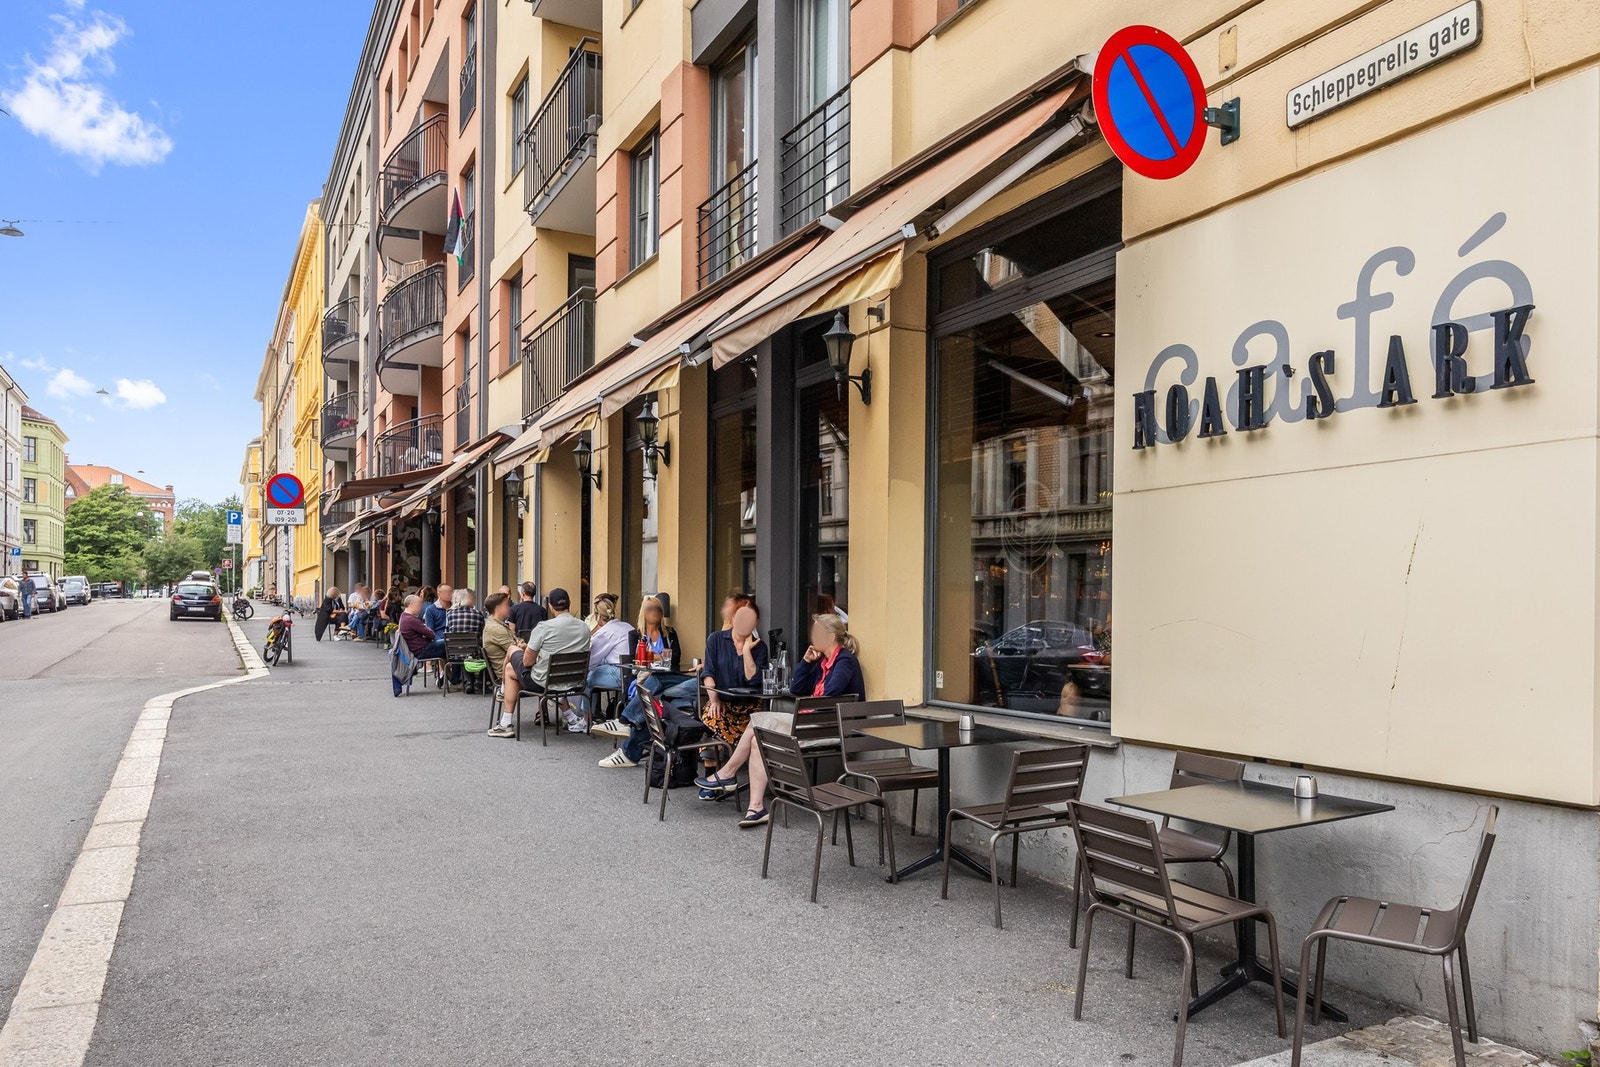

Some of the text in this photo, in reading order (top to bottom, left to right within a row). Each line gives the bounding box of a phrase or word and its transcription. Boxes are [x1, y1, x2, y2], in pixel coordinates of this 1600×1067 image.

[1293, 16, 1470, 116] Schleppegrells gate
[1132, 304, 1536, 450] NOAH'S ARK
[1143, 211, 1534, 446] café
[231, 512, 239, 523] P
